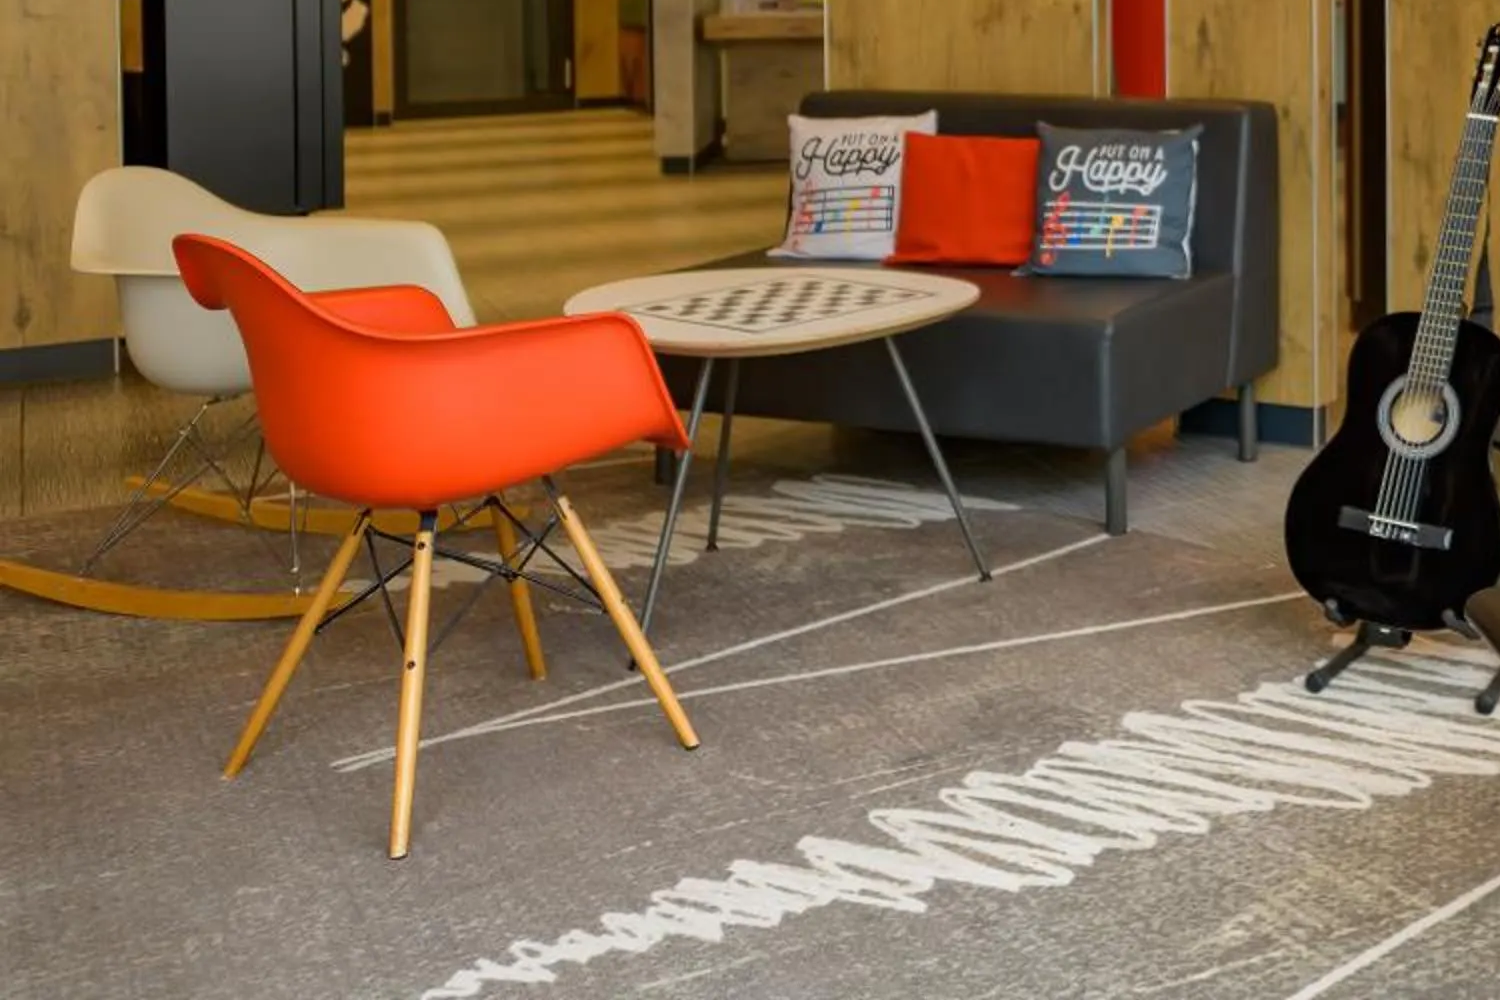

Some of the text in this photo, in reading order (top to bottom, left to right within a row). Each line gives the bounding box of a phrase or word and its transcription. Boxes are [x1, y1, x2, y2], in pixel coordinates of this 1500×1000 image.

[795, 135, 900, 180] Happy
[1048, 145, 1168, 196] Happy
[1153, 146, 1164, 160] A
